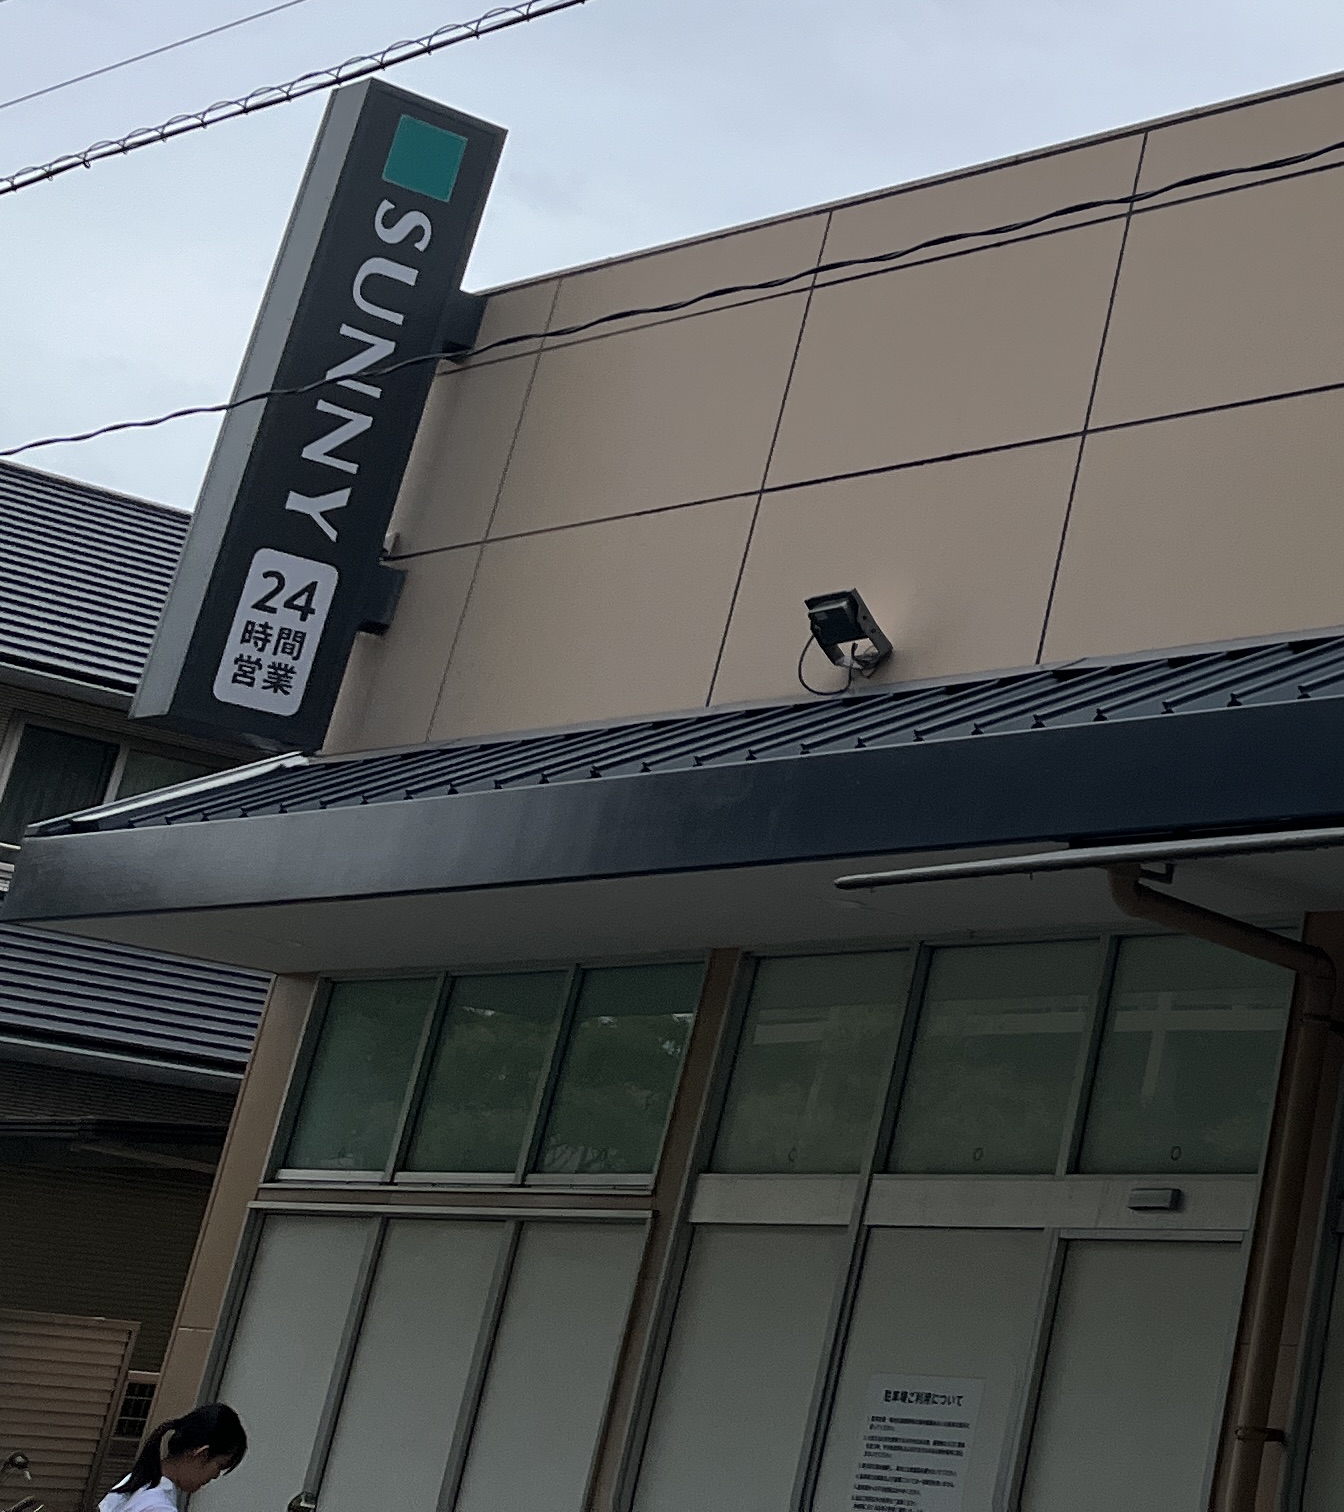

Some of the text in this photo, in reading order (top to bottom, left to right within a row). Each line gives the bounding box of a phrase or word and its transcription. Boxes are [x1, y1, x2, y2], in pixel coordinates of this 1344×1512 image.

[285, 198, 432, 543] SUNNY
[251, 570, 318, 623] 24
[240, 620, 307, 661] 時間
[231, 653, 297, 696] 営業
